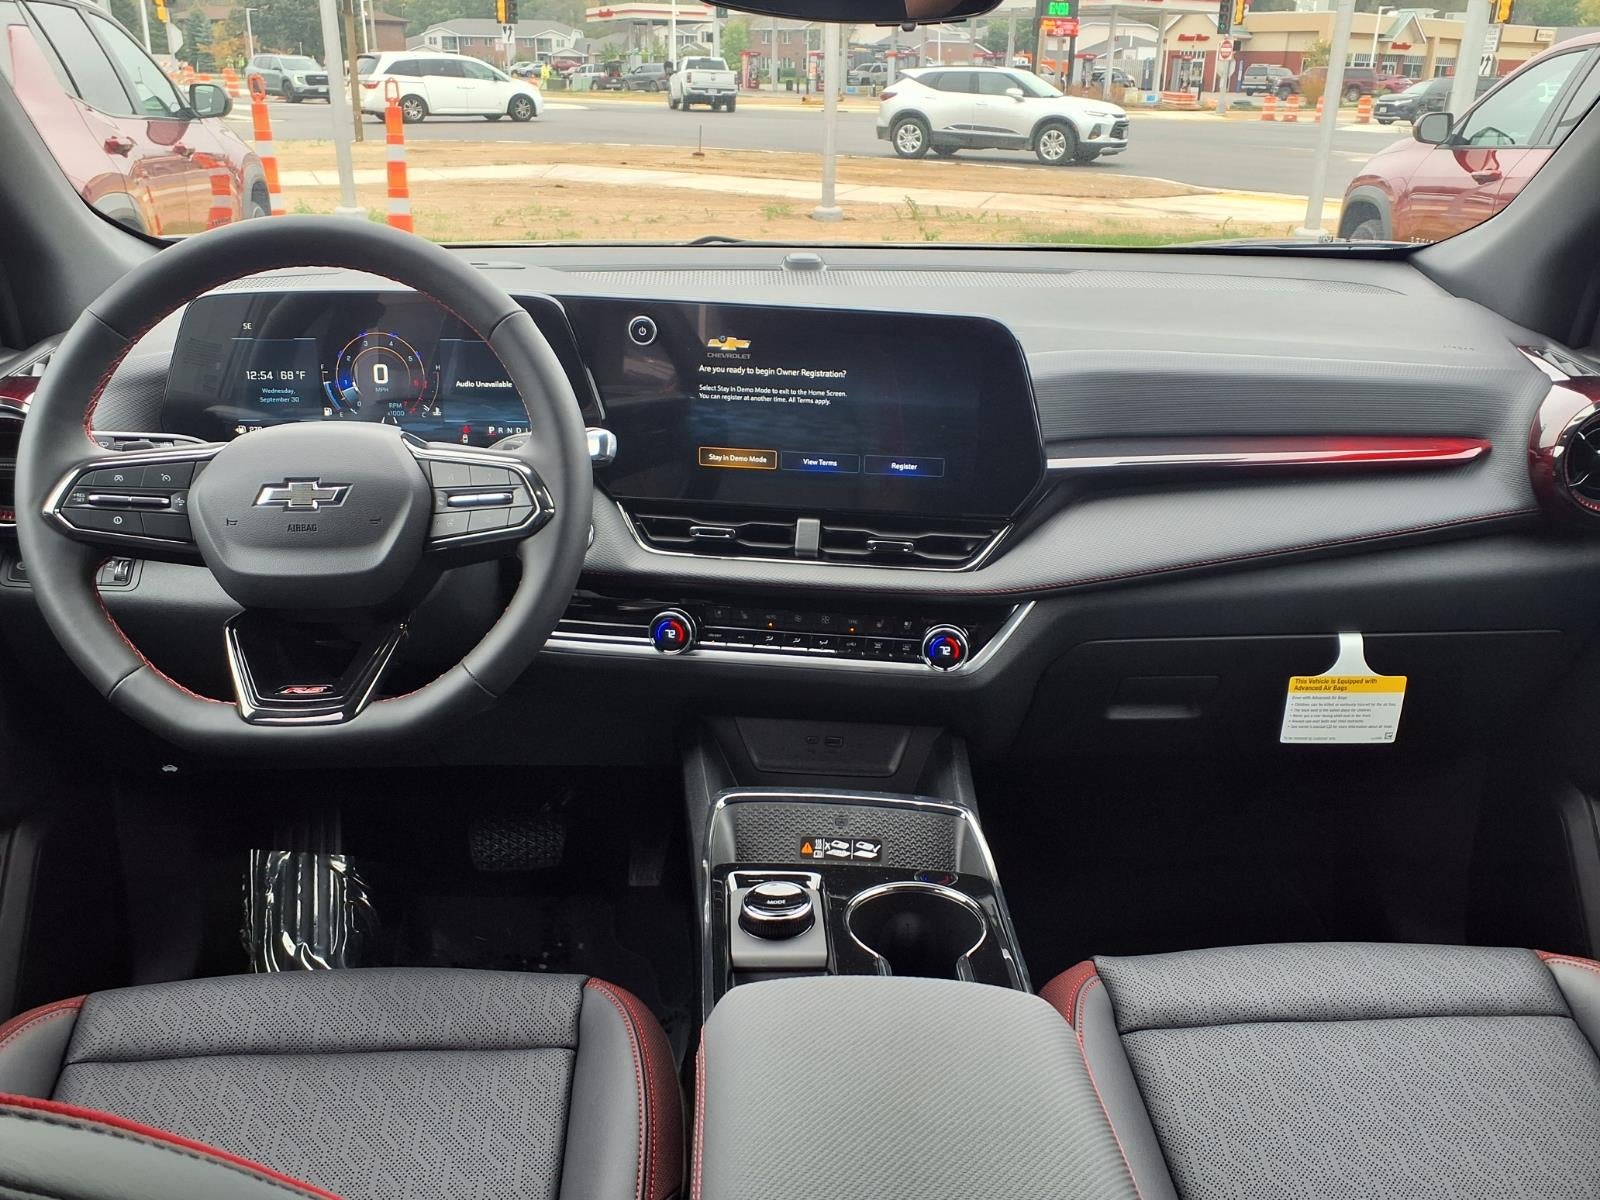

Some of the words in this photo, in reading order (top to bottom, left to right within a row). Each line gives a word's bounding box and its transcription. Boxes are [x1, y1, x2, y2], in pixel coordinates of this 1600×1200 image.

[242, 322, 253, 330] SE
[246, 371, 274, 380] 12:54
[372, 363, 389, 384] 0
[712, 366, 725, 374] you
[726, 366, 746, 375] ready
[755, 367, 775, 376] begin
[776, 368, 800, 376] Owner
[801, 369, 847, 378] Registration?
[455, 380, 474, 388] Audio
[475, 380, 513, 388] Unavailable
[261, 387, 296, 395] Wednesday,
[717, 385, 729, 393] Stay
[259, 396, 290, 404] September
[721, 393, 742, 401] register
[814, 398, 831, 406] apply.
[488, 426, 495, 434] P
[708, 453, 722, 462] Stay
[729, 454, 748, 462] Demo
[749, 455, 767, 463] Mode
[803, 458, 818, 466] View
[818, 459, 837, 467] Terms
[891, 462, 918, 471] Register
[287, 523, 318, 532] AIRBAG
[664, 629, 676, 639] 72
[939, 646, 951, 656] 72
[1337, 678, 1363, 686] Equipped
